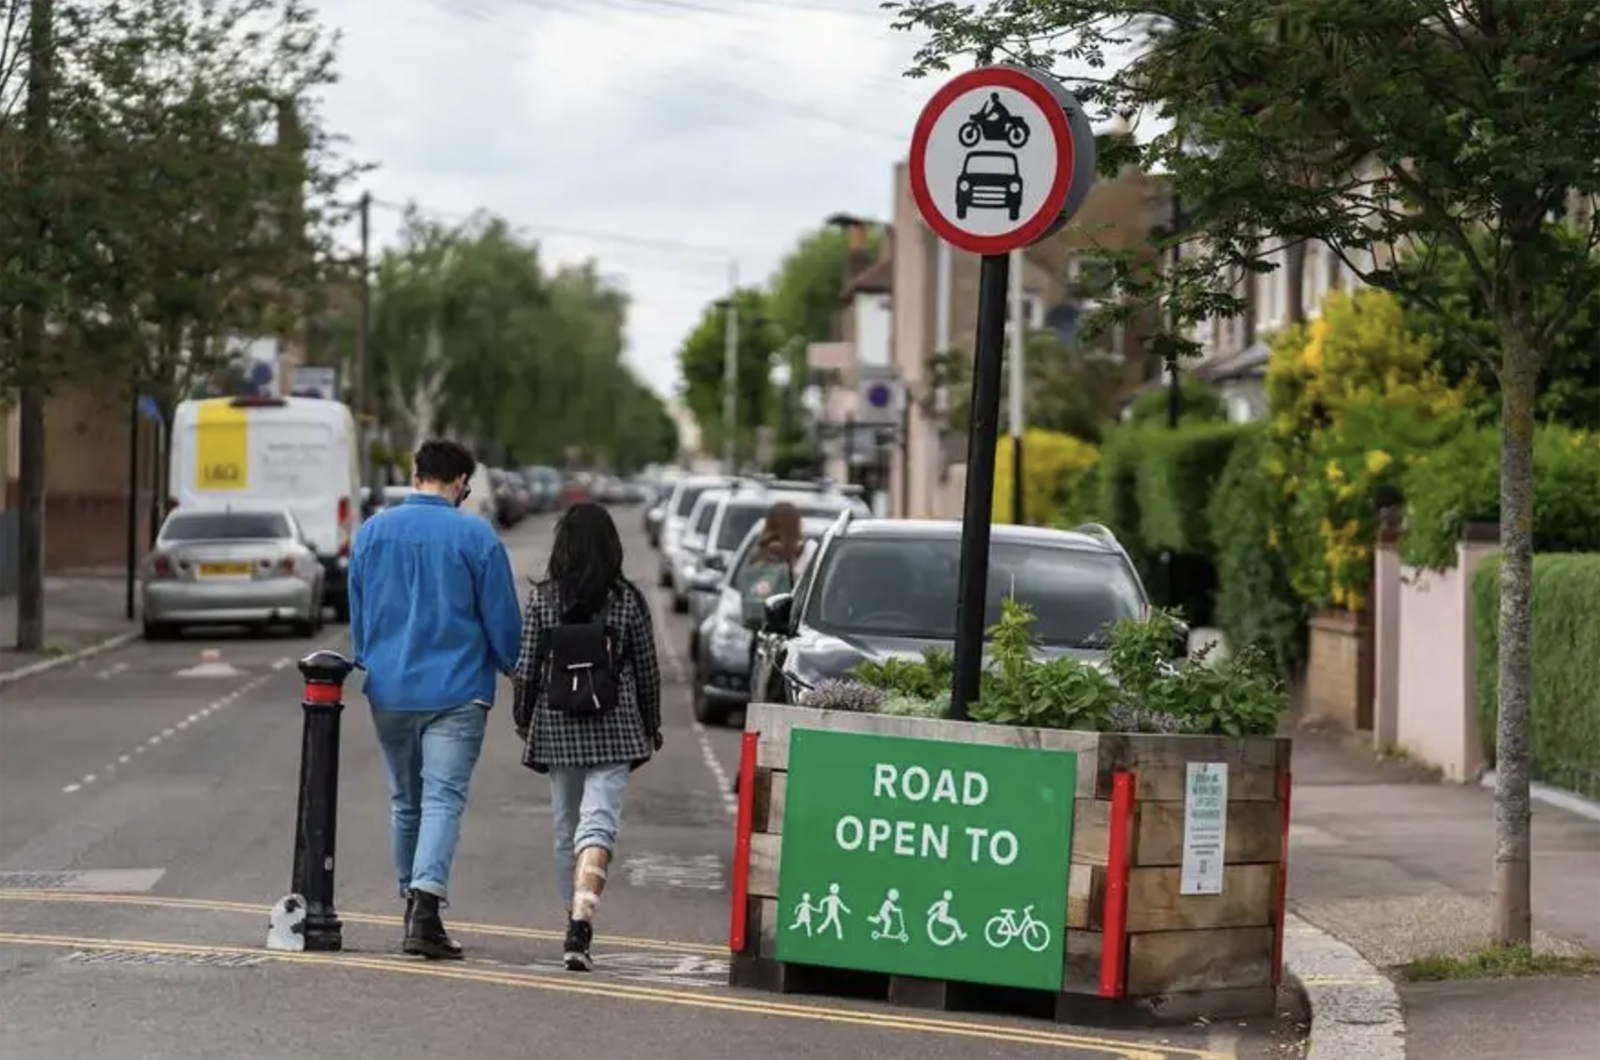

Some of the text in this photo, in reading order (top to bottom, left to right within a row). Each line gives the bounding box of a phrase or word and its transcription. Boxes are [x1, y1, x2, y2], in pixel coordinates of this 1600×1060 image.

[874, 763, 989, 806] ROAD
[835, 815, 1019, 866] OPEN TO
